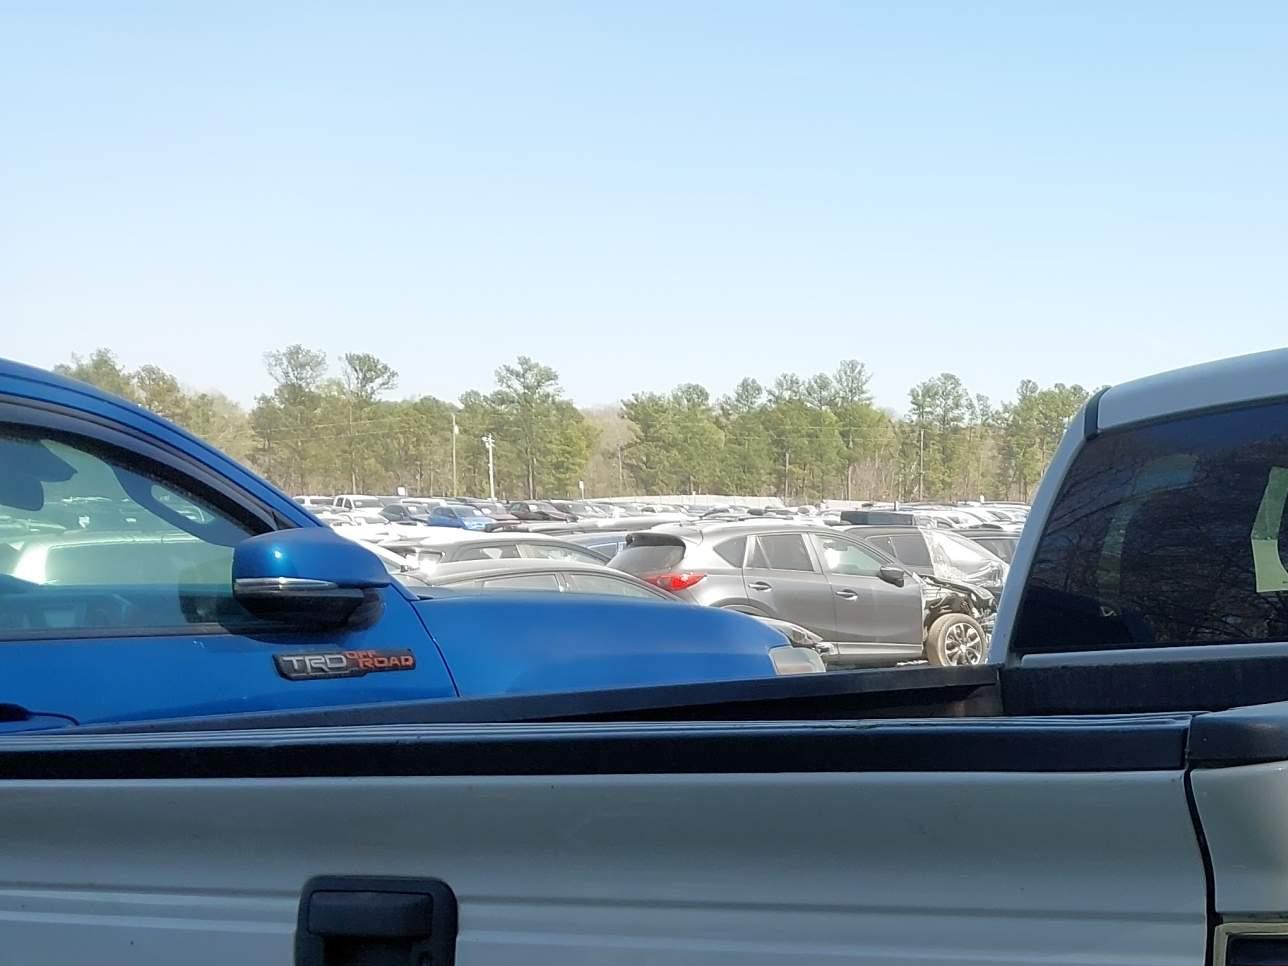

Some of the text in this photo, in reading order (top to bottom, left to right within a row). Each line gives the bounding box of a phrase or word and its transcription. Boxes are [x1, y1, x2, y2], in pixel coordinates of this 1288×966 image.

[345, 649, 377, 659] OFF
[281, 654, 347, 672] TRD
[358, 656, 414, 669] ROAD
